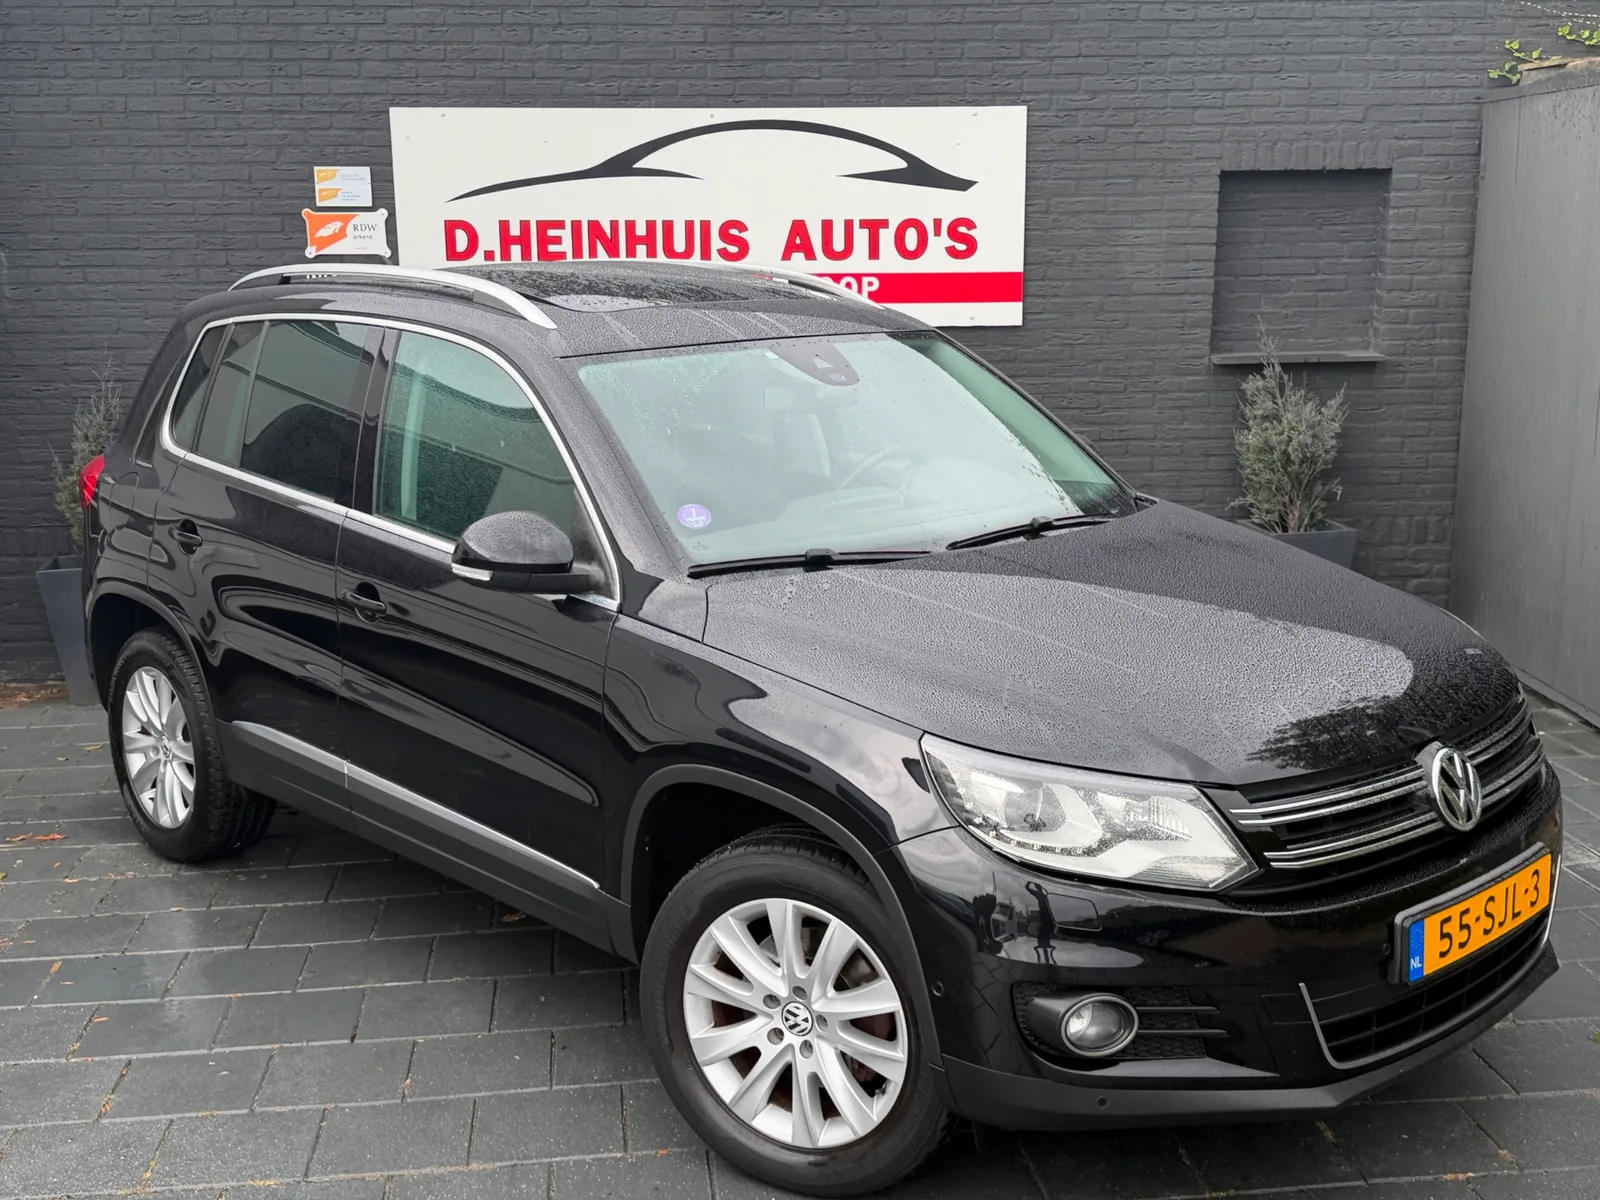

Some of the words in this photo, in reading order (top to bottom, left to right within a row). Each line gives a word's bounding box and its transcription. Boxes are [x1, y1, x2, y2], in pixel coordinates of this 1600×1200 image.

[353, 223, 377, 232] RDW
[444, 219, 750, 261] D.HEINHUIS
[781, 217, 978, 261] AUTO'S
[1438, 868, 1540, 959] 55-SJL-3
[1410, 955, 1423, 970] NL
